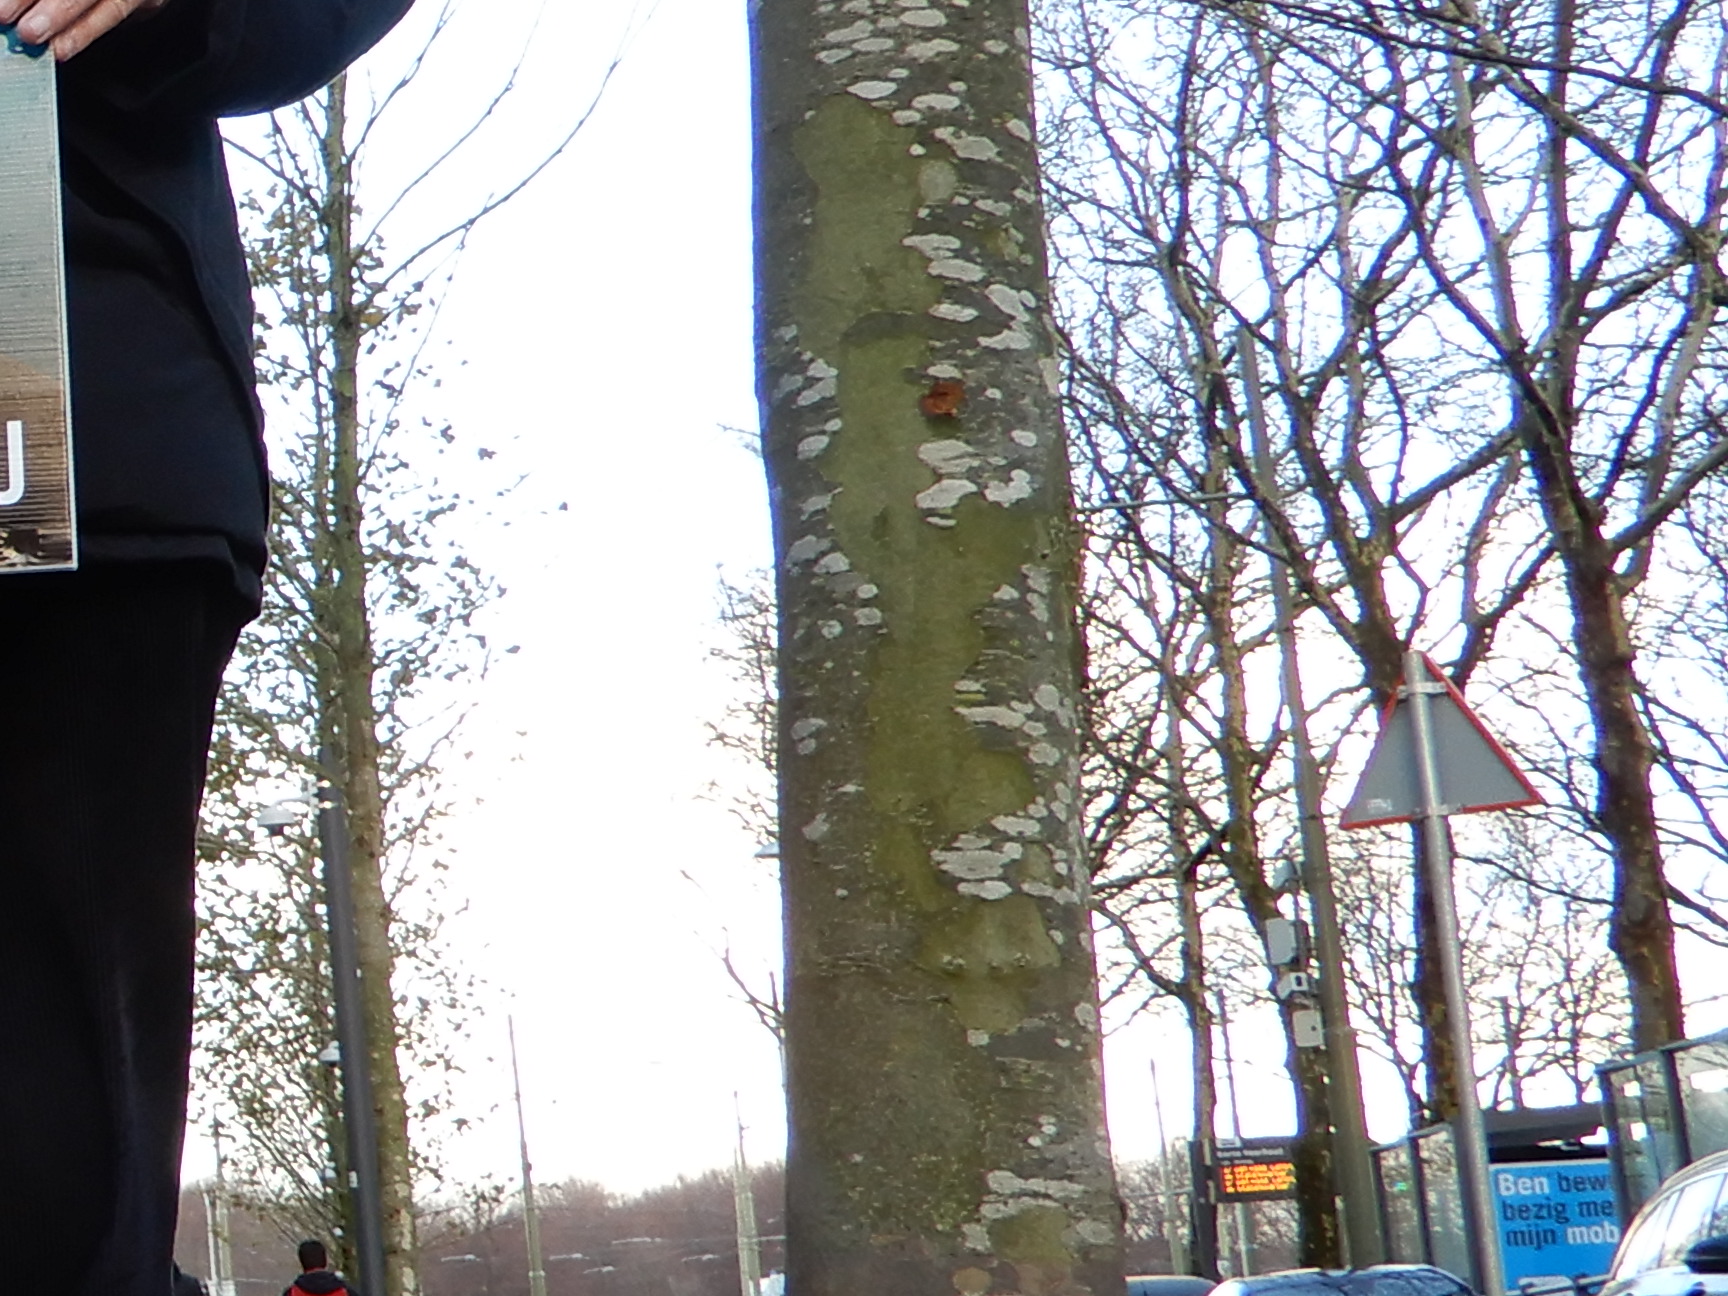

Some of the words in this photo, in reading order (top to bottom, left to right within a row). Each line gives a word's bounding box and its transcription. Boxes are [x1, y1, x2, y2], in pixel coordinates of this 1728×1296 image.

[1497, 1172, 1550, 1196] Ben
[1557, 1170, 1607, 1193] bew
[1501, 1196, 1570, 1224] bezig
[1578, 1199, 1614, 1217] me
[1505, 1225, 1557, 1251] mijn
[1566, 1220, 1621, 1245] mob
